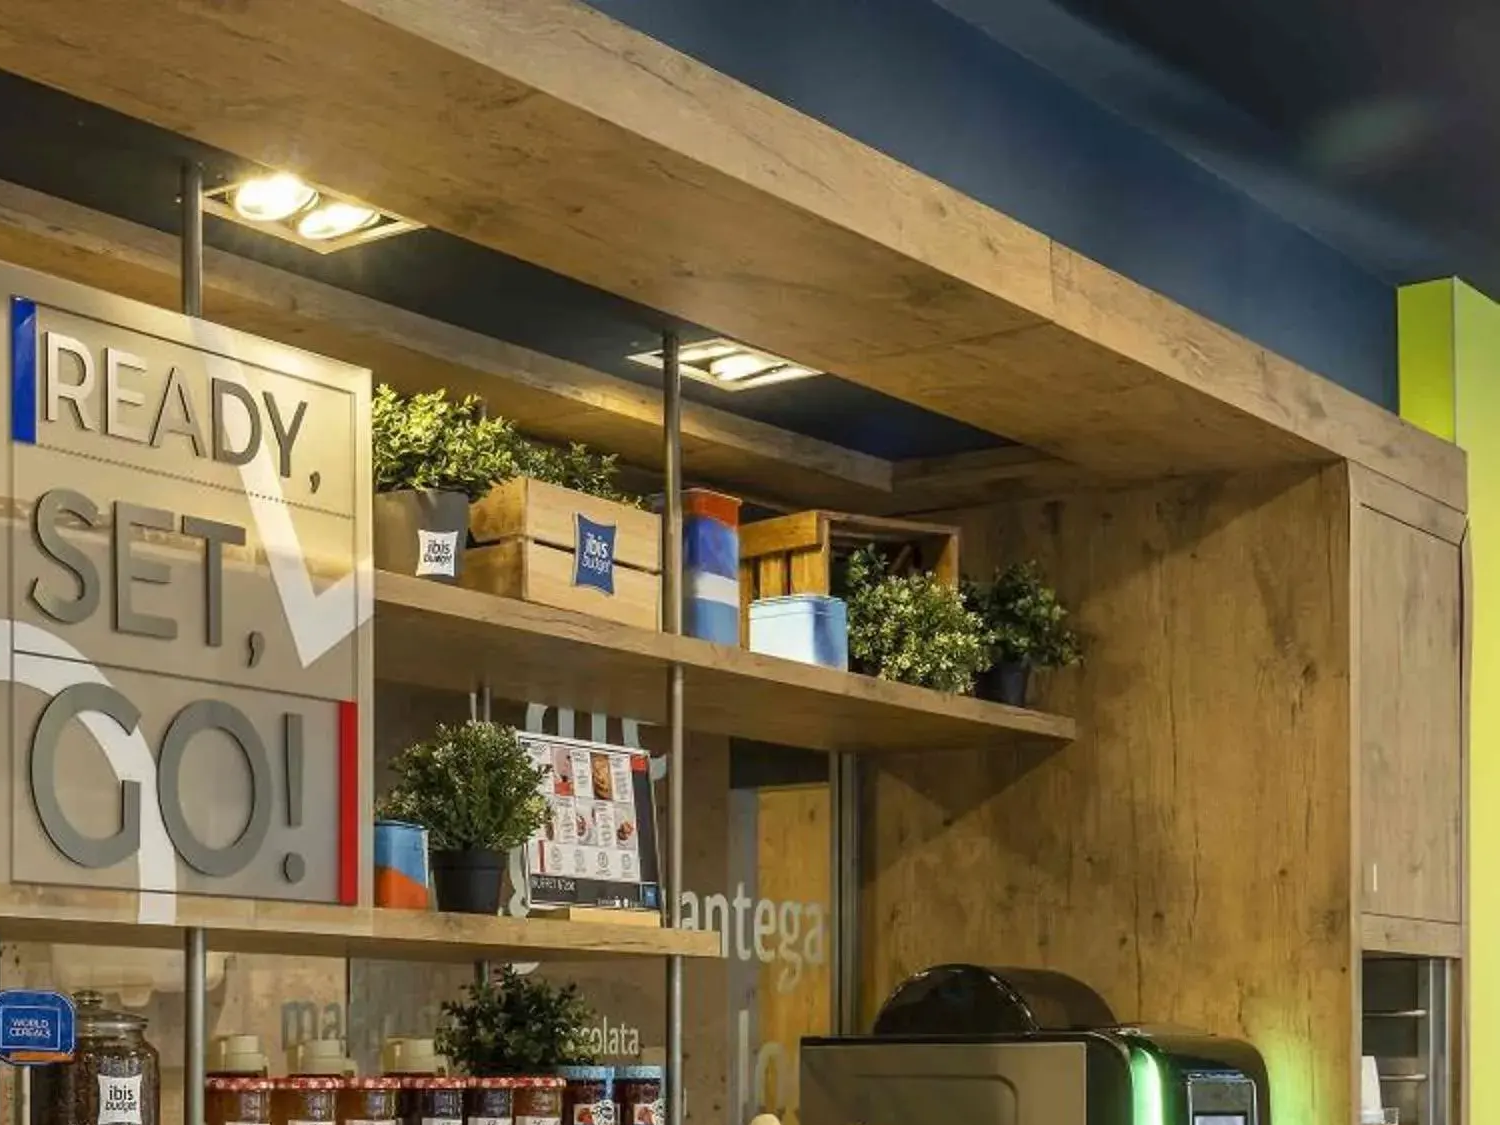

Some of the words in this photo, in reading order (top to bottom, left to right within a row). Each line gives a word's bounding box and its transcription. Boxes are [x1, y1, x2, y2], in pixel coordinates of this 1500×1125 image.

[41, 329, 321, 494] READY,
[427, 540, 450, 555] ibis
[584, 532, 609, 558] ibis
[28, 487, 265, 669] SET,
[29, 681, 306, 884] GO!
[11, 1018, 49, 1028] WORLD
[9, 1028, 51, 1038] CEREALS
[108, 1085, 134, 1101] ibis
[105, 1099, 137, 1112] budget
